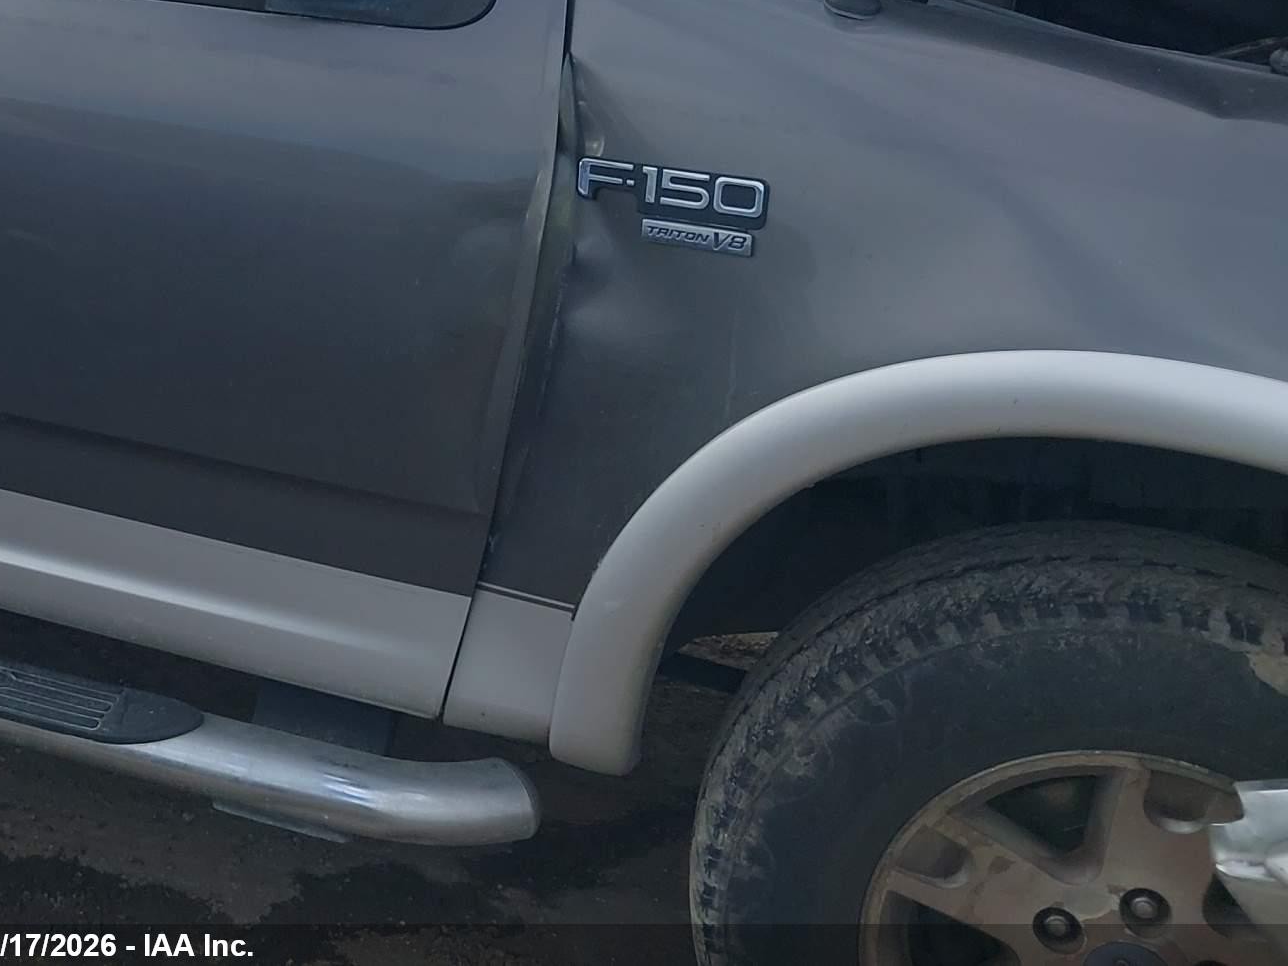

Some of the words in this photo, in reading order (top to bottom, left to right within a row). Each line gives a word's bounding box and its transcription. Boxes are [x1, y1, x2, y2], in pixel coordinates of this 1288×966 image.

[577, 157, 766, 219] F-150
[645, 225, 710, 244] TRITON
[710, 231, 748, 251] V8
